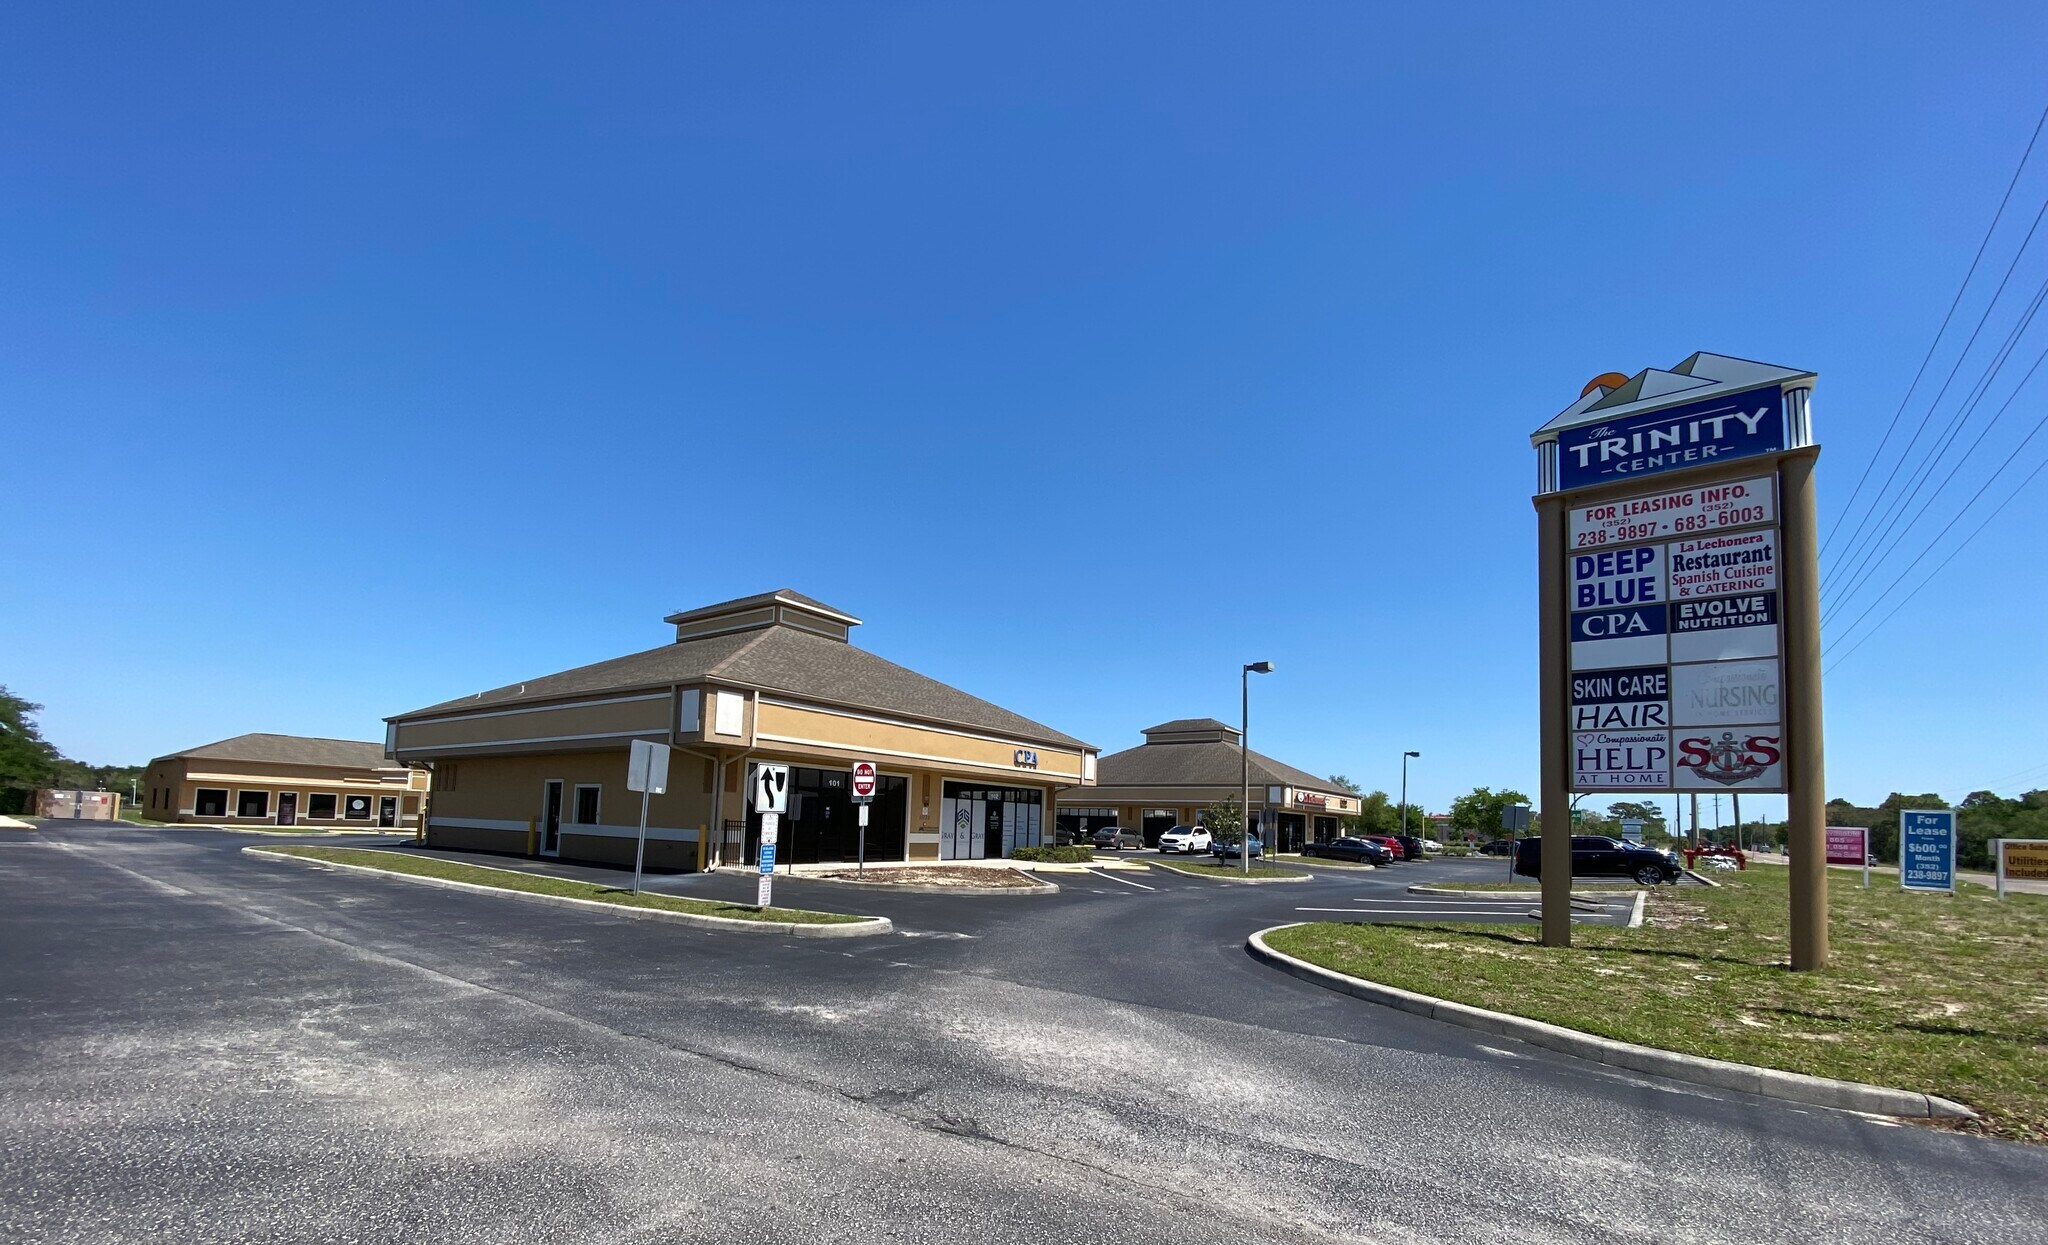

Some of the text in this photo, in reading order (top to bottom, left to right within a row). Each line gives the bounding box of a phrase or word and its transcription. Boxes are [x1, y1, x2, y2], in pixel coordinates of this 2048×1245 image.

[1569, 407, 1769, 468] TRINITY
[1588, 427, 1617, 440] The
[1616, 445, 1718, 473] CENTER
[1586, 485, 1750, 523] FOR LEASING INFO.
[1702, 501, 1734, 513] (352)
[1577, 505, 1765, 547] 238-9897 683-6003
[1602, 517, 1632, 529] (352)
[1680, 533, 1764, 554] La Lechonera
[1575, 547, 1656, 581] DEEP
[1672, 544, 1773, 573] Restaurant
[1672, 563, 1774, 588] Spanish Cuisine
[1577, 576, 1657, 609] BLUE
[1679, 578, 1766, 597] & CATERING
[1680, 596, 1766, 618] EVOLVE
[1581, 611, 1650, 637] CPA
[1678, 612, 1769, 630] NUTRITION
[1573, 673, 1667, 700] SKIN CARE
[1690, 684, 1778, 709] NURSING
[1576, 703, 1667, 730] HAIR
[1597, 733, 1668, 748] Compassionate
[1014, 749, 1038, 765] CPA
[1577, 747, 1667, 771] HELP
[828, 779, 841, 787] 101
[1578, 773, 1665, 784] AT HOME
[1908, 825, 1948, 836] Lease
[1916, 815, 1939, 825] For
[1914, 854, 1941, 862] Month
[1915, 862, 1940, 871] (352)
[1907, 869, 1949, 881] 238-9897
